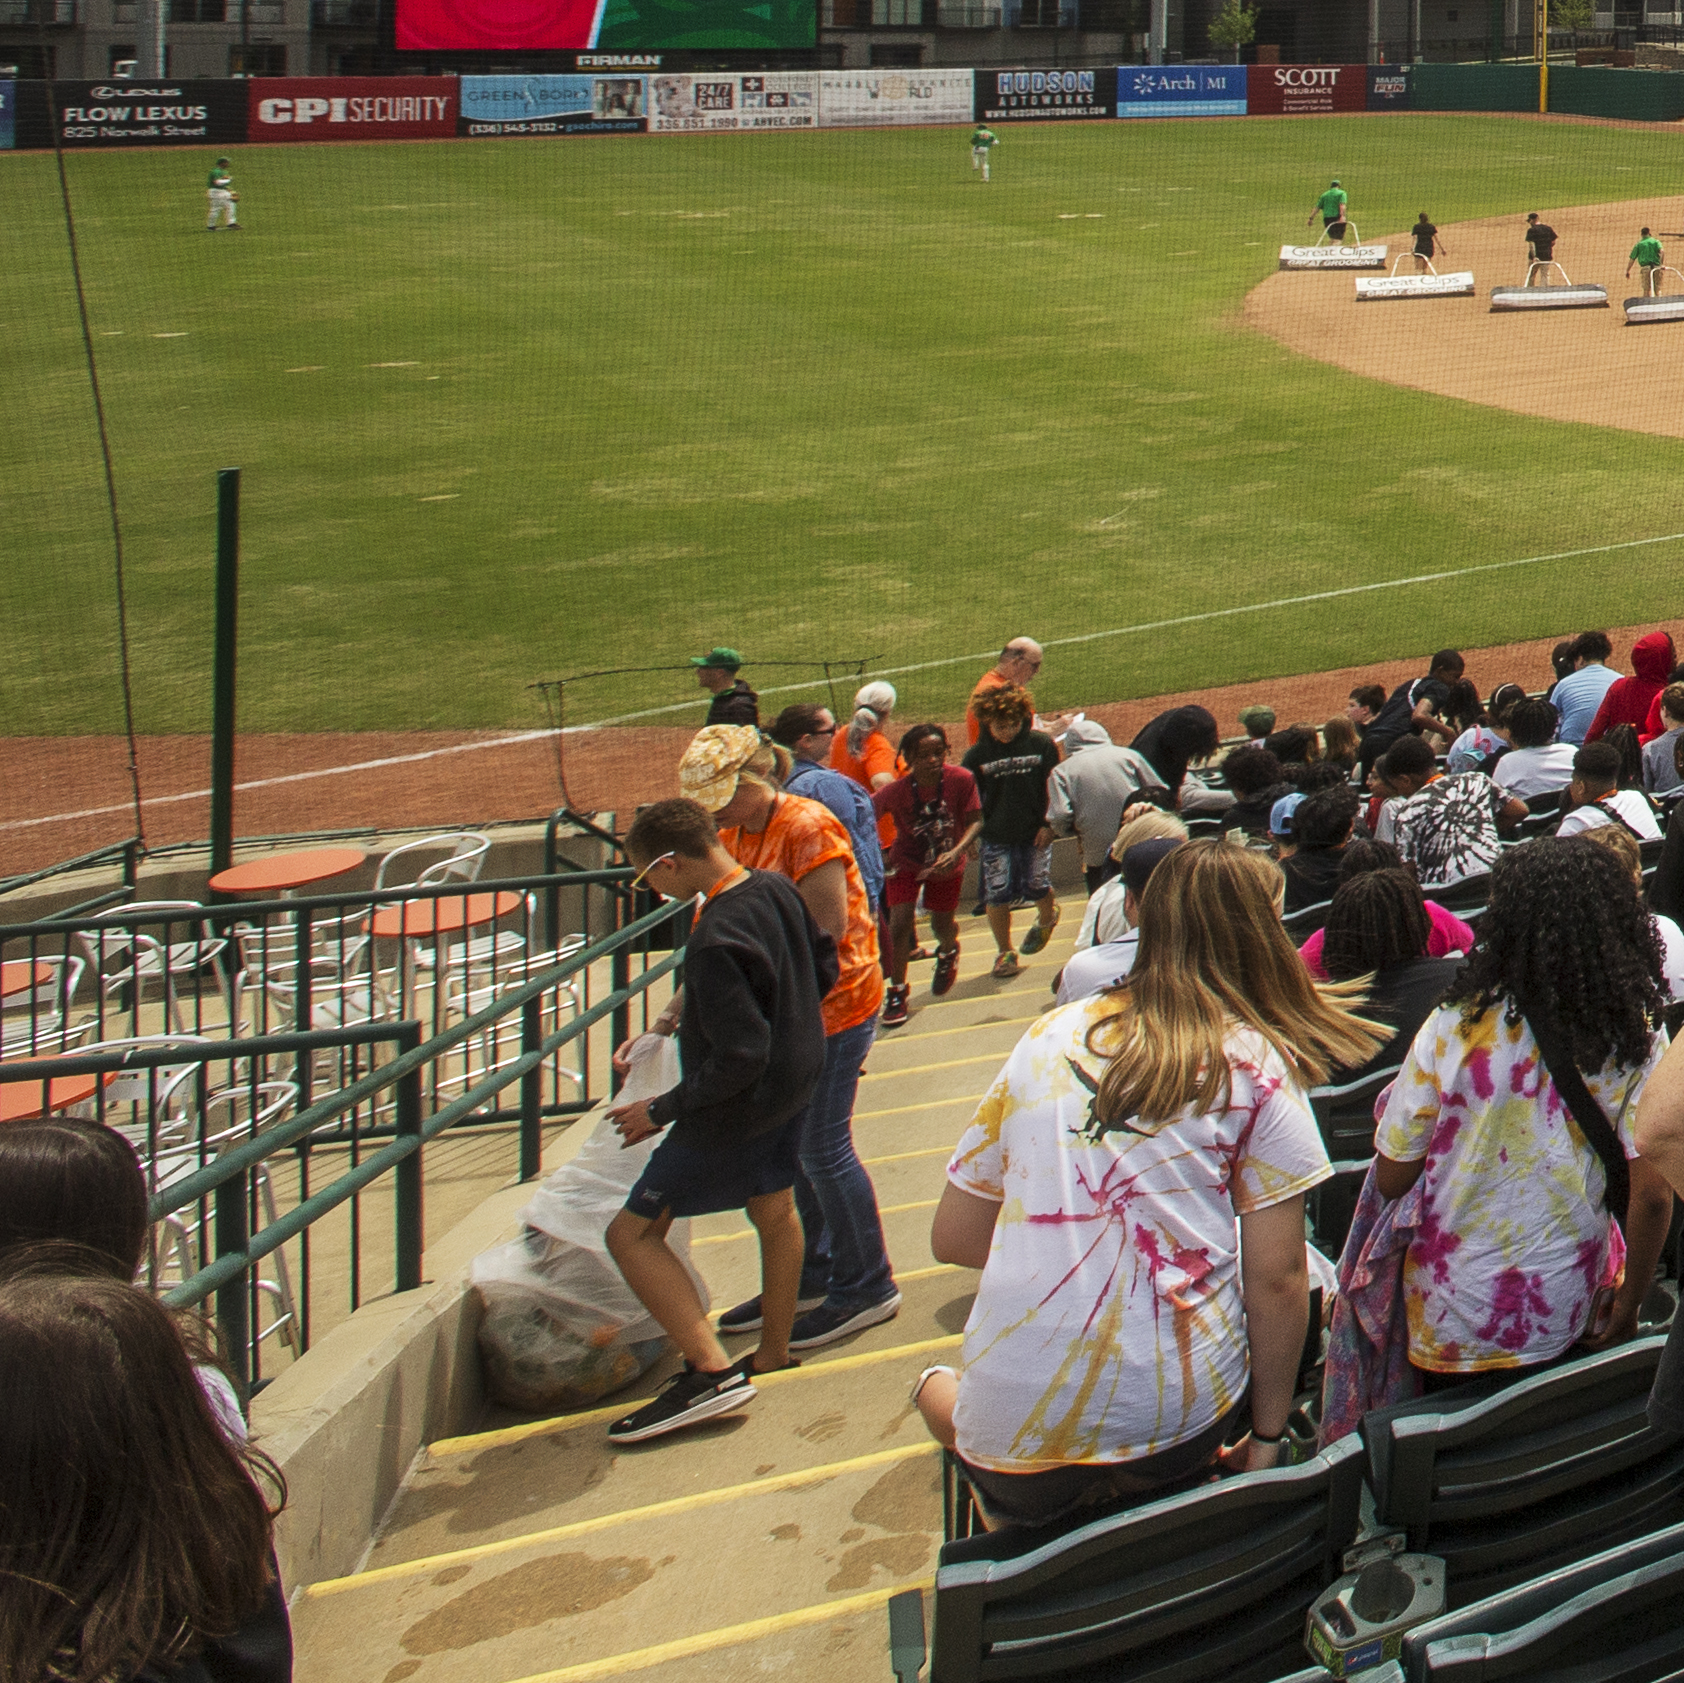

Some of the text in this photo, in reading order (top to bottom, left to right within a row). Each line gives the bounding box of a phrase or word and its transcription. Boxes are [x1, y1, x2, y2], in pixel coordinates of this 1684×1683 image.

[576, 54, 661, 66] FIRMAN
[997, 71, 1095, 94] HUDSON
[1157, 75, 1226, 91] Arch MI
[1274, 68, 1341, 86] SCOTT
[1375, 76, 1405, 84] MAJOR
[699, 84, 732, 98] 24/7
[1284, 87, 1333, 95] INSURANCE
[699, 96, 732, 109] CARE
[999, 94, 1095, 107] AUTOWORKS
[64, 105, 208, 122] FLOW LEXUS
[258, 95, 450, 124] CPI SECURITY
[63, 124, 206, 138] 825 Norwalk Street
